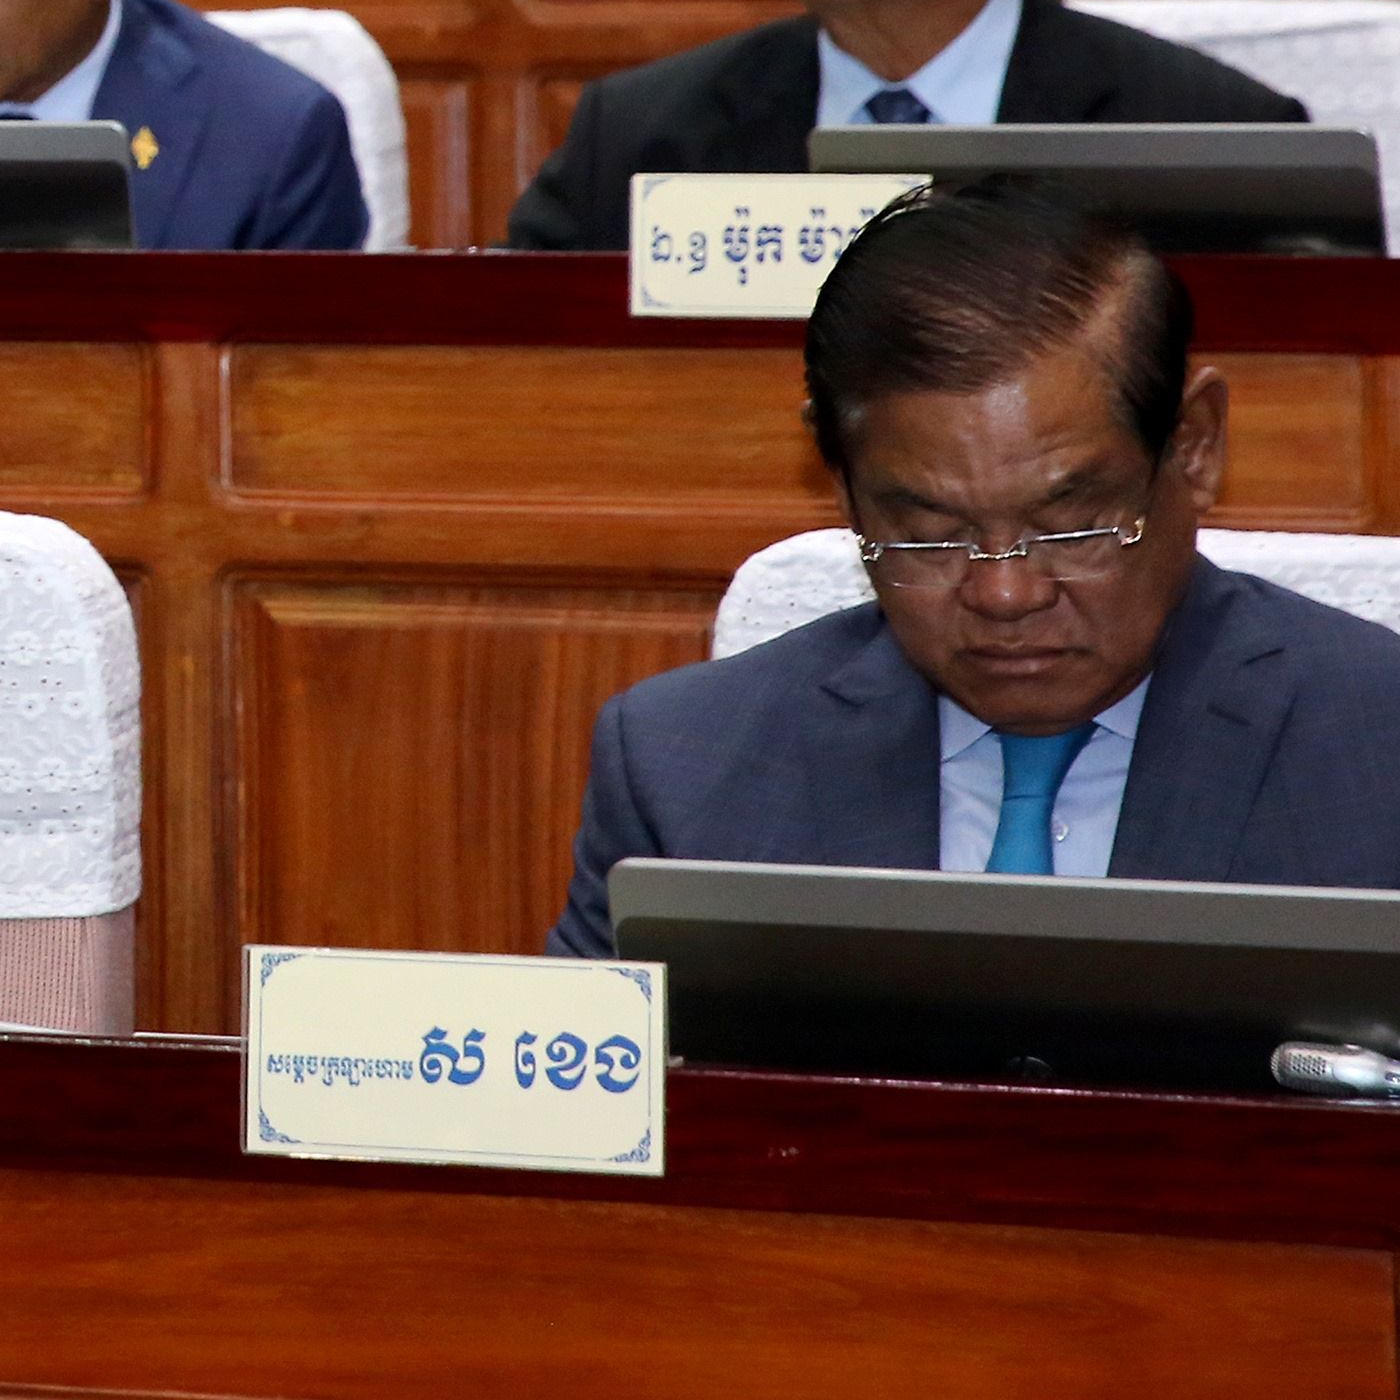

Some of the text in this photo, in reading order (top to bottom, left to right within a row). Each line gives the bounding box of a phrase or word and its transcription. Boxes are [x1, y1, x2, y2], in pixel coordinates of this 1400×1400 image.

[723, 207, 783, 285] ម៉ុក
[419, 1026, 487, 1086] ស
[515, 1031, 642, 1094] ខេង
